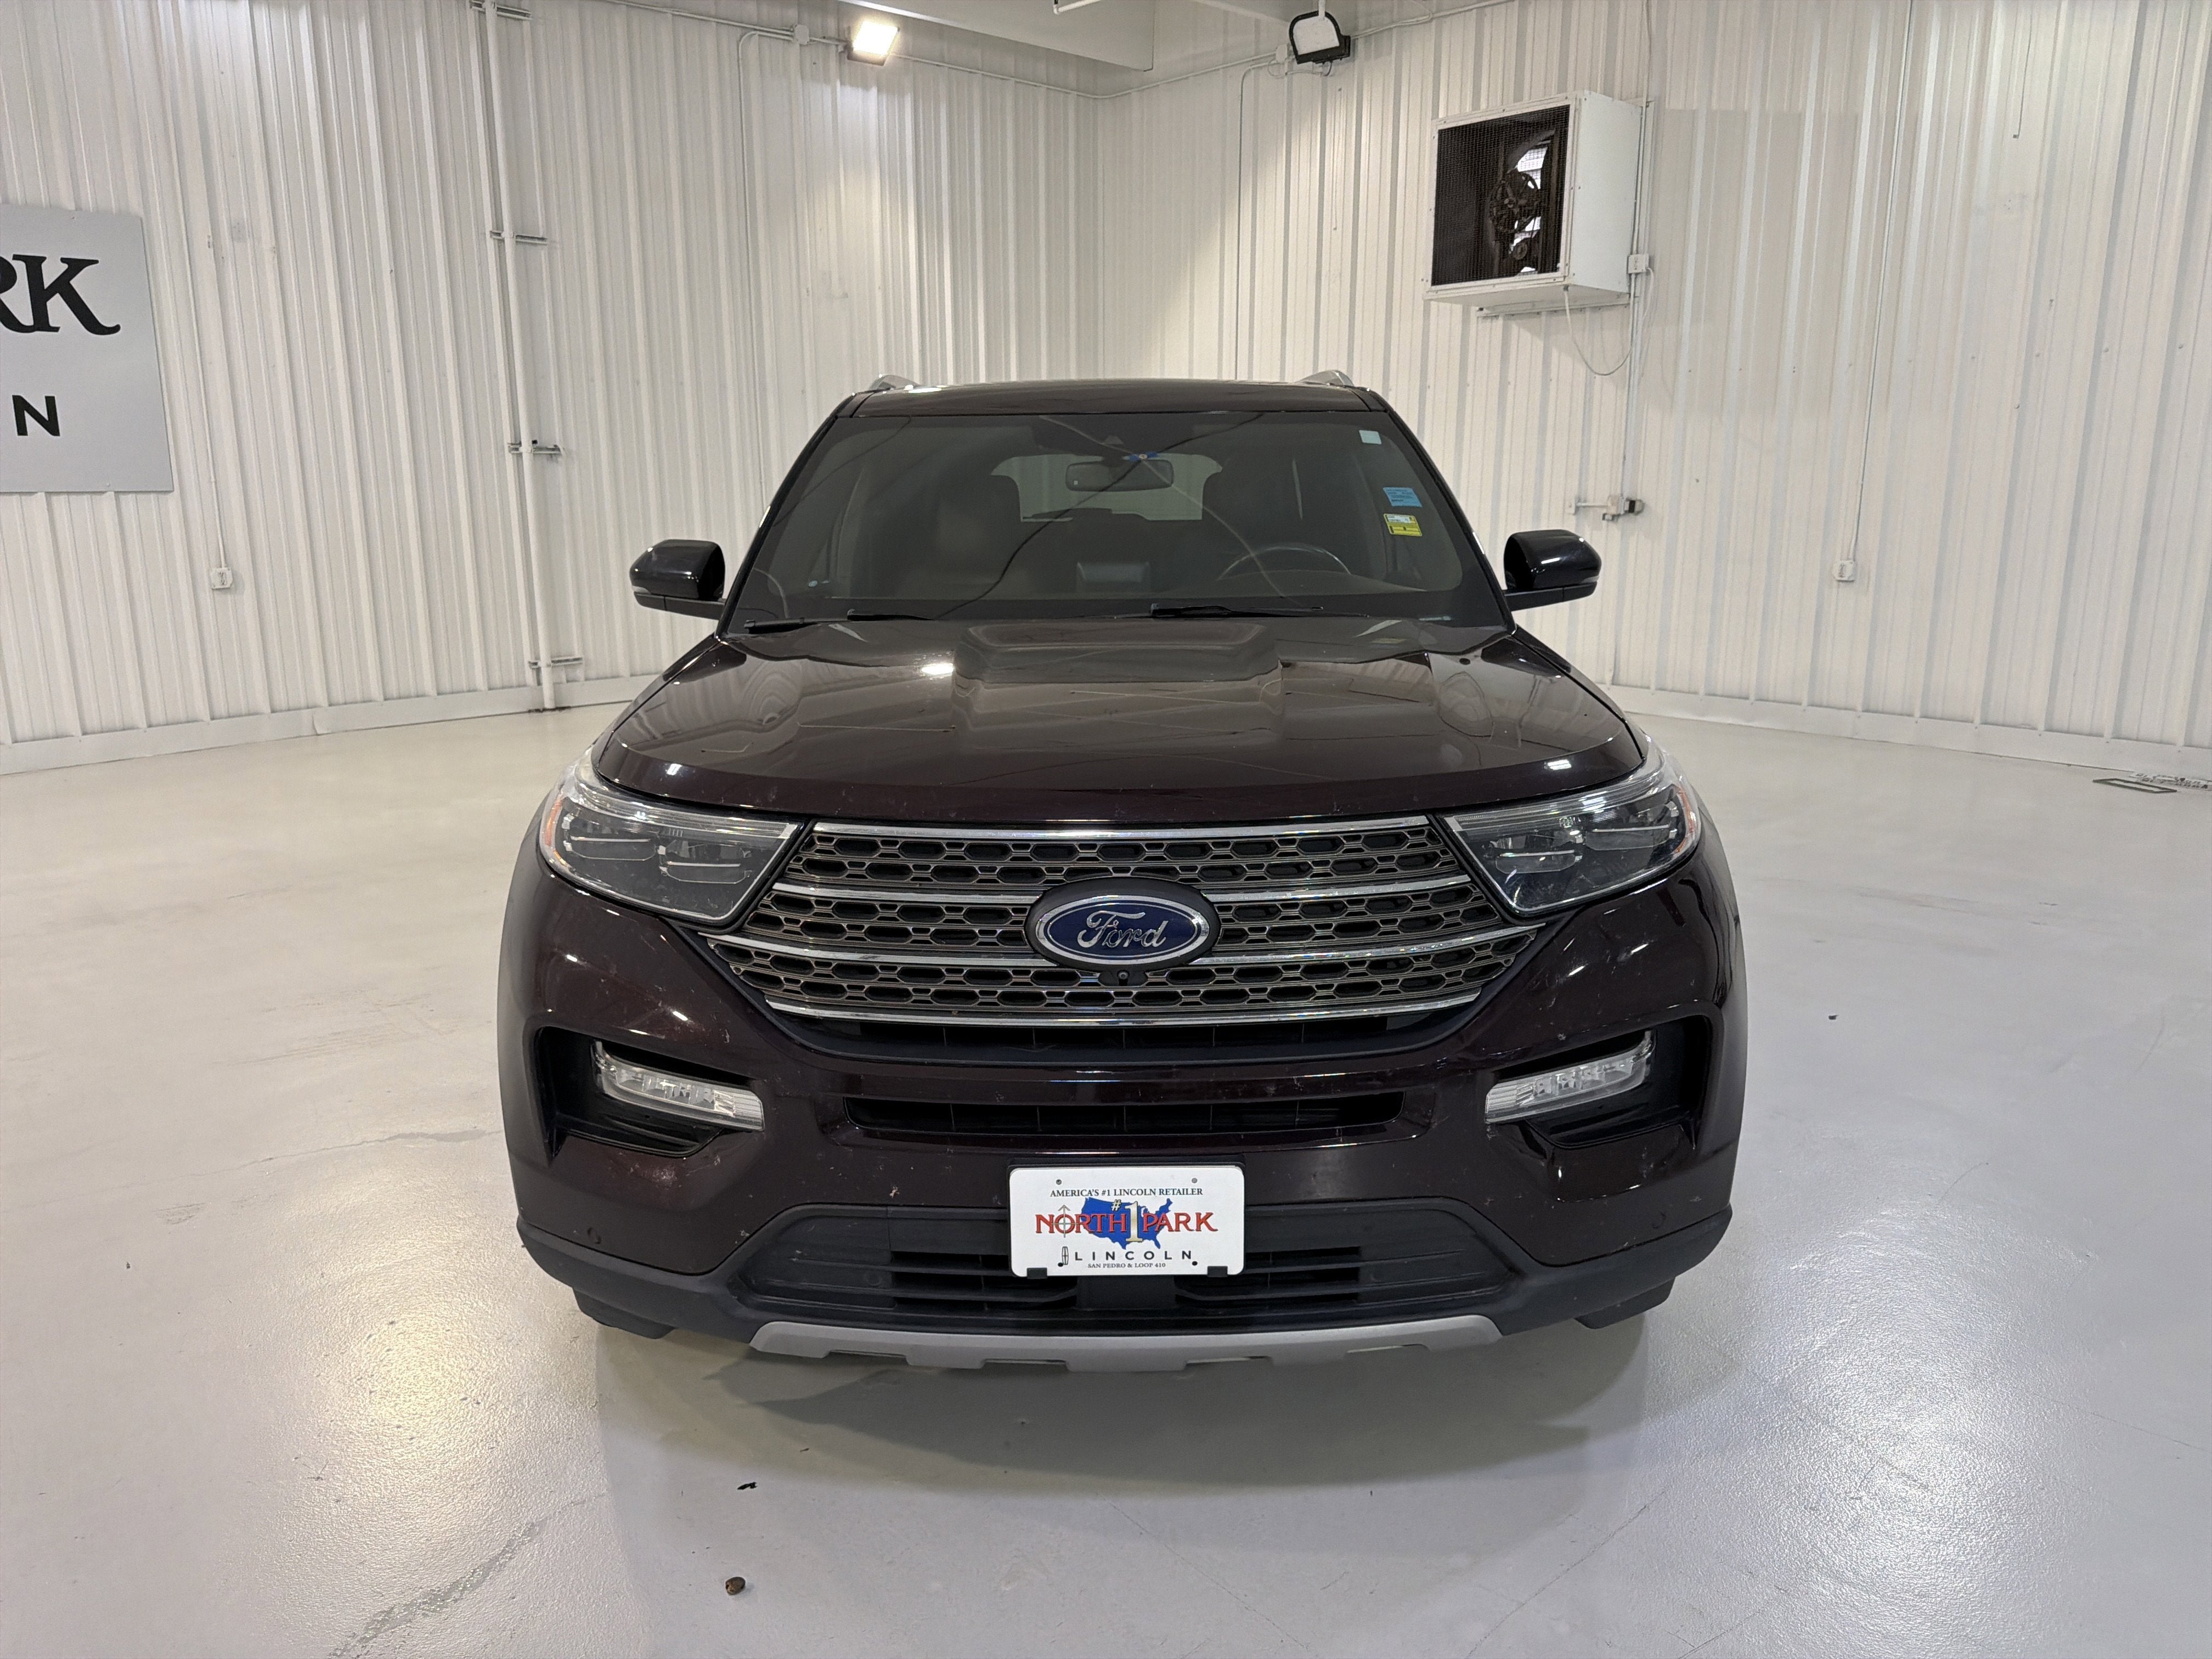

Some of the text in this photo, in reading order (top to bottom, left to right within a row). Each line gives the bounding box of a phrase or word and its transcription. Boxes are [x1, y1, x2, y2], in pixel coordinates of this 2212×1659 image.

[12, 394, 60, 436] N
[1077, 910, 1169, 947] Ford
[1035, 1213, 1126, 1233] NORTH
[1143, 1212, 1218, 1232] PARK
[1075, 1250, 1192, 1261] LINCOLN
